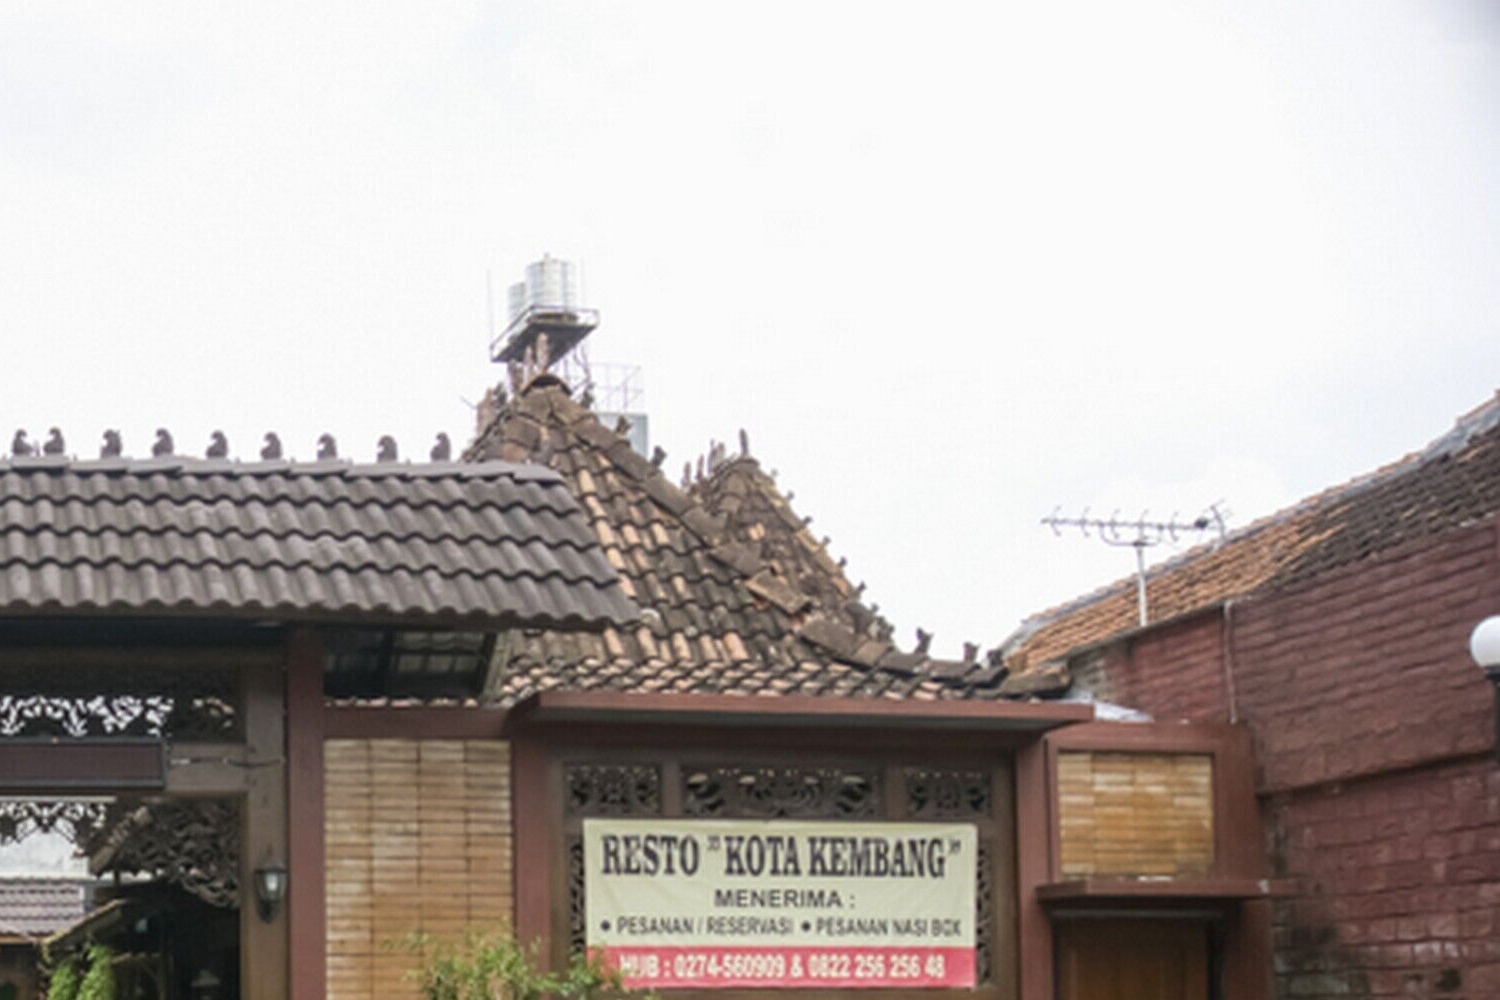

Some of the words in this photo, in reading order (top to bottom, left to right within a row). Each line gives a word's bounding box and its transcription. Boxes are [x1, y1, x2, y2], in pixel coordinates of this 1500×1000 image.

[601, 834, 700, 877] RESTO
[616, 915, 694, 936] PESANAN
[706, 915, 794, 936] RESERVASI
[816, 916, 889, 937] PESANAN
[892, 917, 927, 938] NASI
[931, 917, 962, 938] BOX
[790, 954, 804, 979] &
[807, 953, 851, 979] 0822
[854, 953, 885, 979] 256
[889, 953, 921, 979] 256
[924, 954, 946, 979] 48
